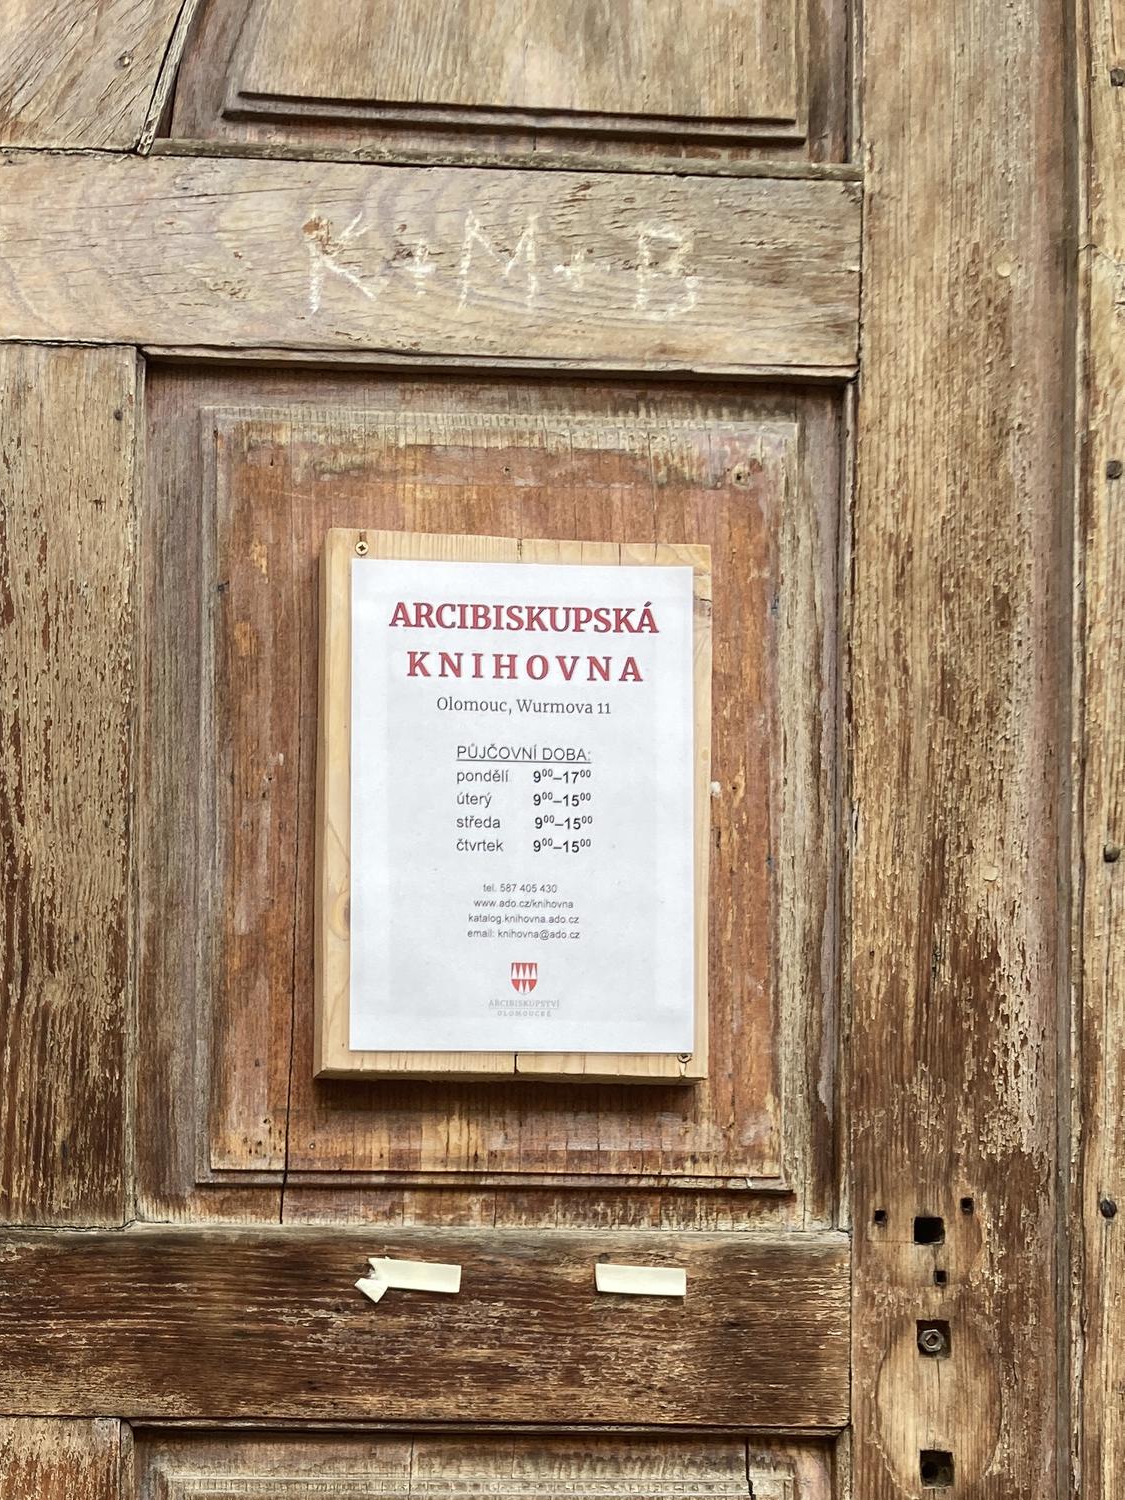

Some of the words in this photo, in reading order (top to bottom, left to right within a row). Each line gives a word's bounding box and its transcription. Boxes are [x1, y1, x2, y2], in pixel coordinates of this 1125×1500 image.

[388, 601, 660, 634] ARCIBISKUPSKÁ
[406, 651, 644, 682] KNIHOVNA
[436, 696, 513, 716] Olomouc,
[516, 699, 594, 715] Wurmova
[597, 703, 612, 715] 11
[456, 744, 538, 761] PŮJČOVNÍ
[541, 747, 592, 762] DOBA:
[456, 770, 509, 784] pondělí
[456, 793, 492, 808] úterý
[456, 817, 501, 830] středa
[456, 839, 504, 853] čtvrtek
[499, 883, 517, 893] 587
[519, 884, 537, 893] 405
[539, 884, 558, 894] 430
[473, 898, 574, 910] www.ado.cz/knihovna
[468, 913, 579, 926] katalog.knihovna.ado.cz
[497, 929, 580, 941] knihovna@ado.cz
